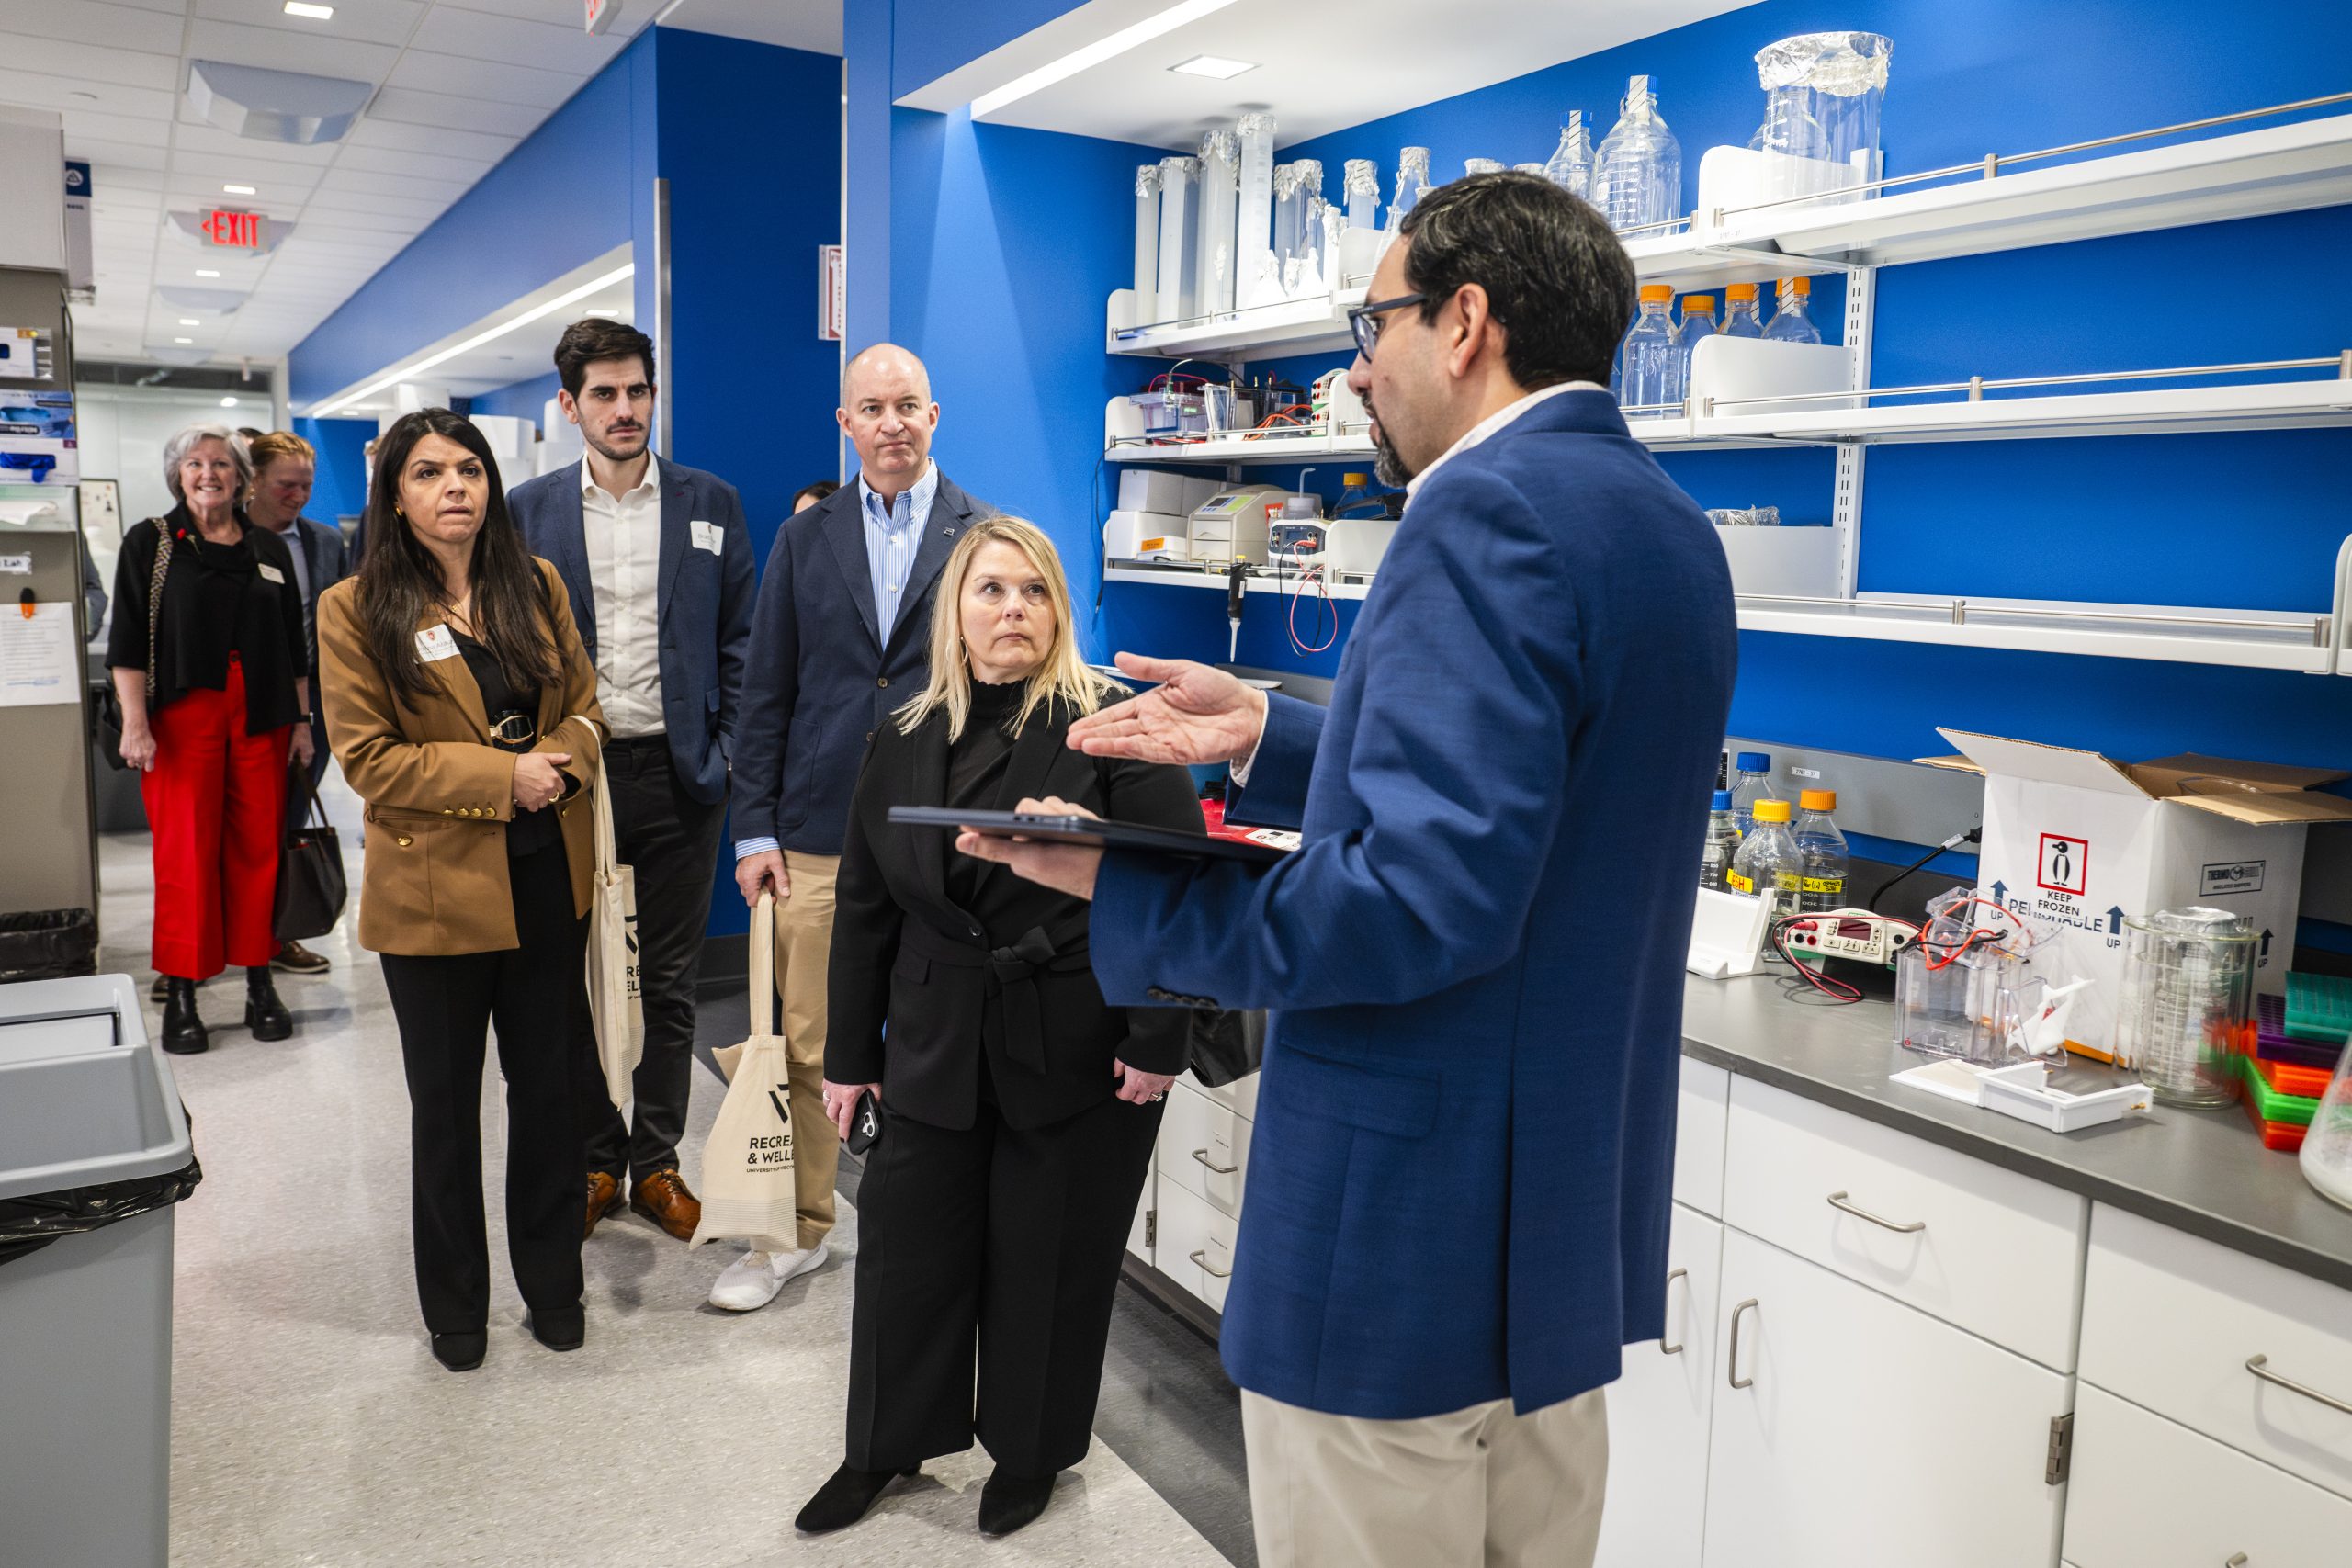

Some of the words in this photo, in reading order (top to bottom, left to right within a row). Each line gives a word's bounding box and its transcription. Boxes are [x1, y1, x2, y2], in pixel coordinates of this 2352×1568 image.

[212, 211, 261, 248] EXIT
[2047, 891, 2073, 903] KEEP
[2038, 899, 2080, 917] FROZEN
[1990, 910, 2004, 921] UP
[2009, 898, 2103, 932] PEABLE
[2106, 938, 2121, 949] UP
[2258, 958, 2268, 968] UP
[749, 1134, 793, 1149] RECRE
[747, 1152, 758, 1164] &
